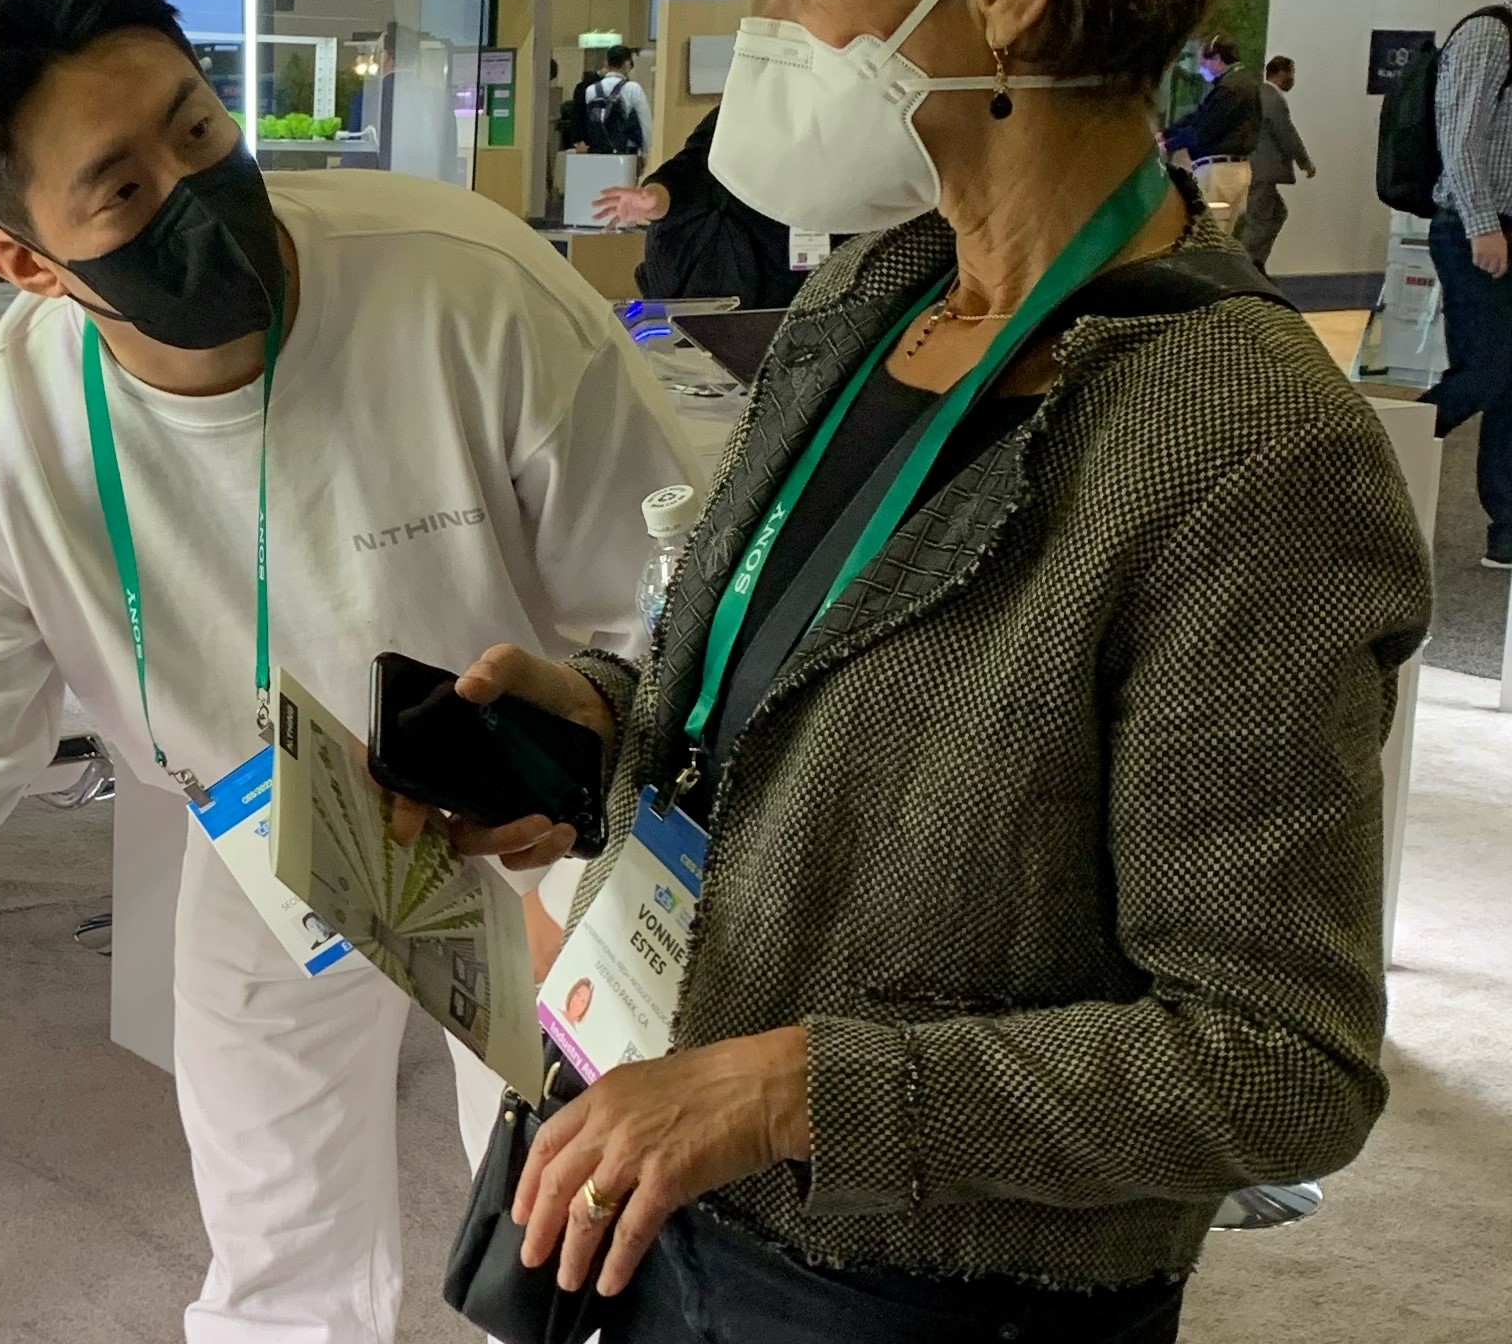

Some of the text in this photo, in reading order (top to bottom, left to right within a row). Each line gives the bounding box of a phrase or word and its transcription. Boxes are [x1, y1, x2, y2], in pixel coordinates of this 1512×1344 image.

[351, 507, 486, 553] N.THING
[734, 501, 786, 595] SONY
[125, 588, 144, 660] SONY
[630, 930, 668, 976] ESTES
[637, 903, 687, 965] VONNIE
[548, 1021, 587, 1068] Industry
